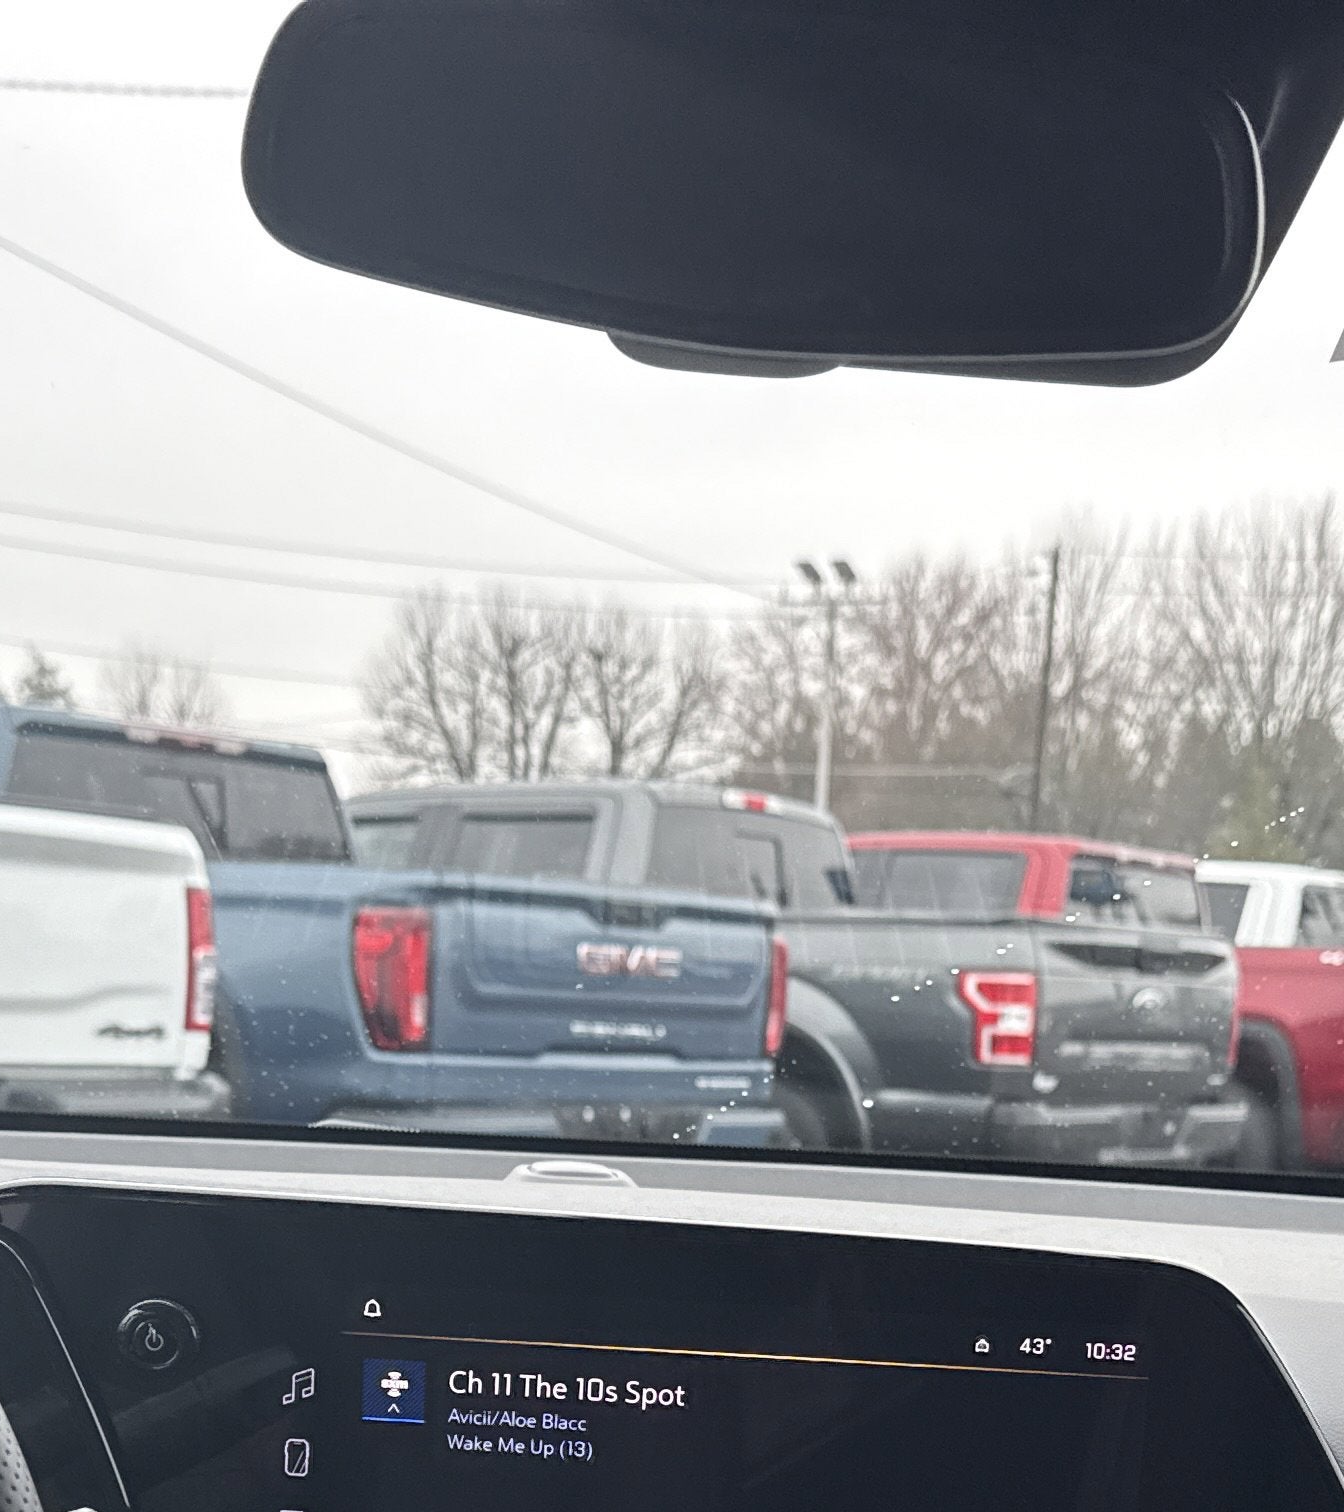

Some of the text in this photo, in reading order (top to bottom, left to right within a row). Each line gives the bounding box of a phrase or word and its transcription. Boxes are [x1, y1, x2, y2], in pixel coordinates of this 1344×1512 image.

[1085, 1343, 1136, 1361] 10:32
[449, 1371, 686, 1409] Ch 11 The 10s Spot
[448, 1408, 587, 1431] Avicii/Aloe Blacc
[447, 1435, 593, 1460] Wake Me Up (13)
